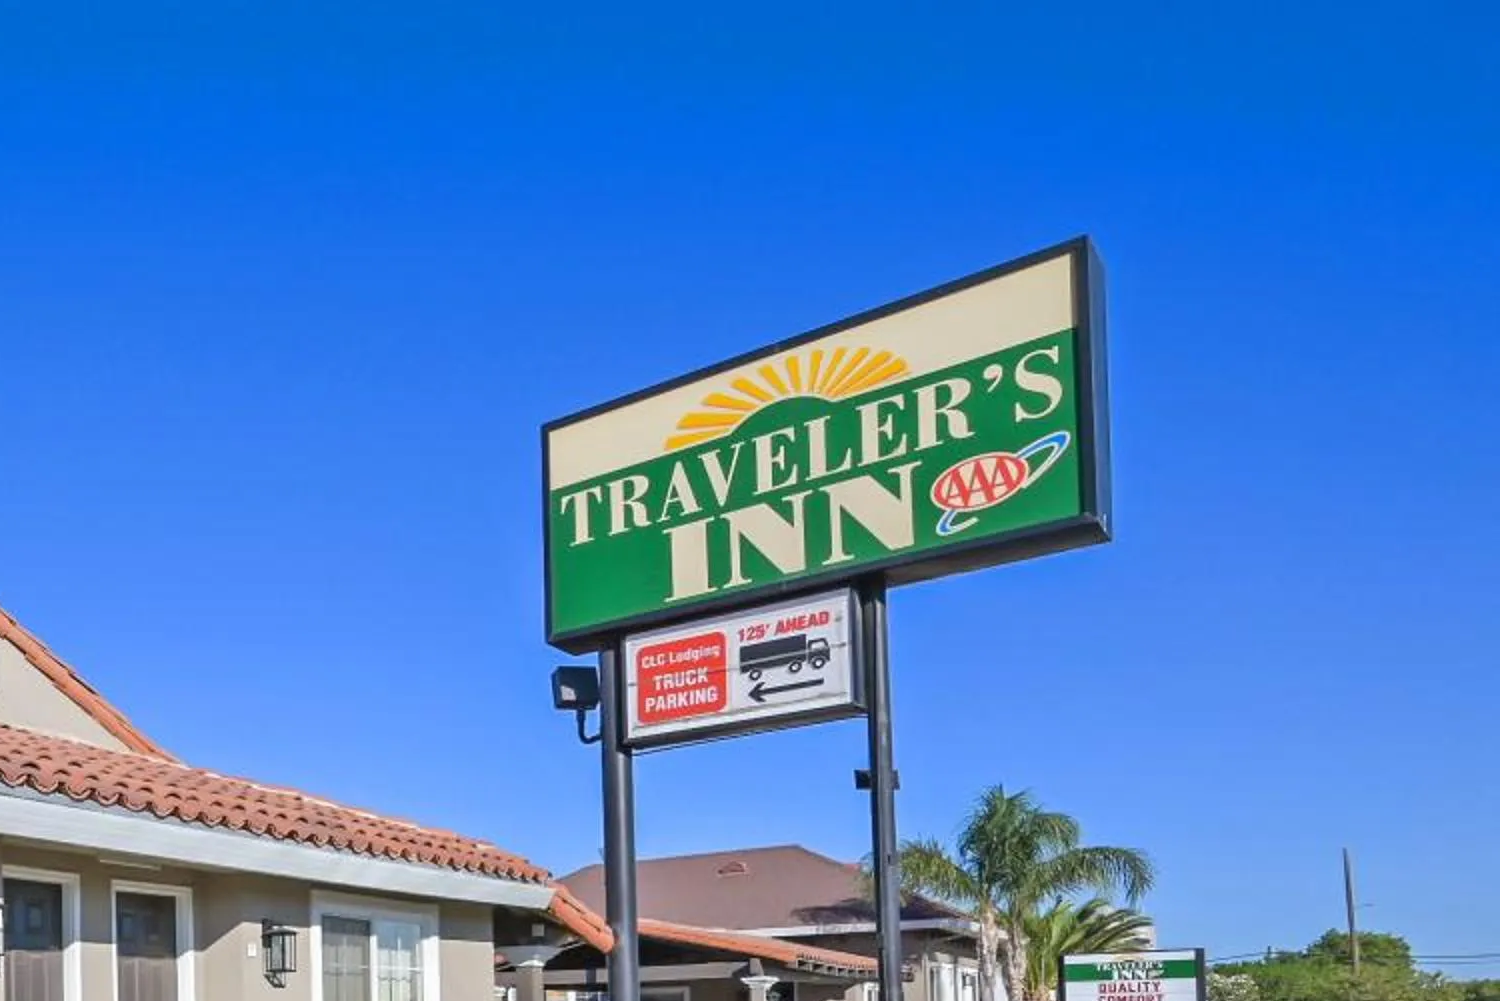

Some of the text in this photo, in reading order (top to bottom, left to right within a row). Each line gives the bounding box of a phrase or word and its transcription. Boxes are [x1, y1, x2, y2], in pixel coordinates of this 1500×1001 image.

[560, 345, 1064, 548] TRAVELER'S
[933, 453, 1027, 510] AAA
[661, 460, 923, 603] INN
[737, 610, 831, 643] 125' AHEAD
[641, 644, 721, 669] CLC Lodging
[652, 667, 709, 691] TRUCK
[644, 686, 719, 713] PARKING
[1098, 981, 1161, 994] QUALITY
[1112, 968, 1150, 981] INN
